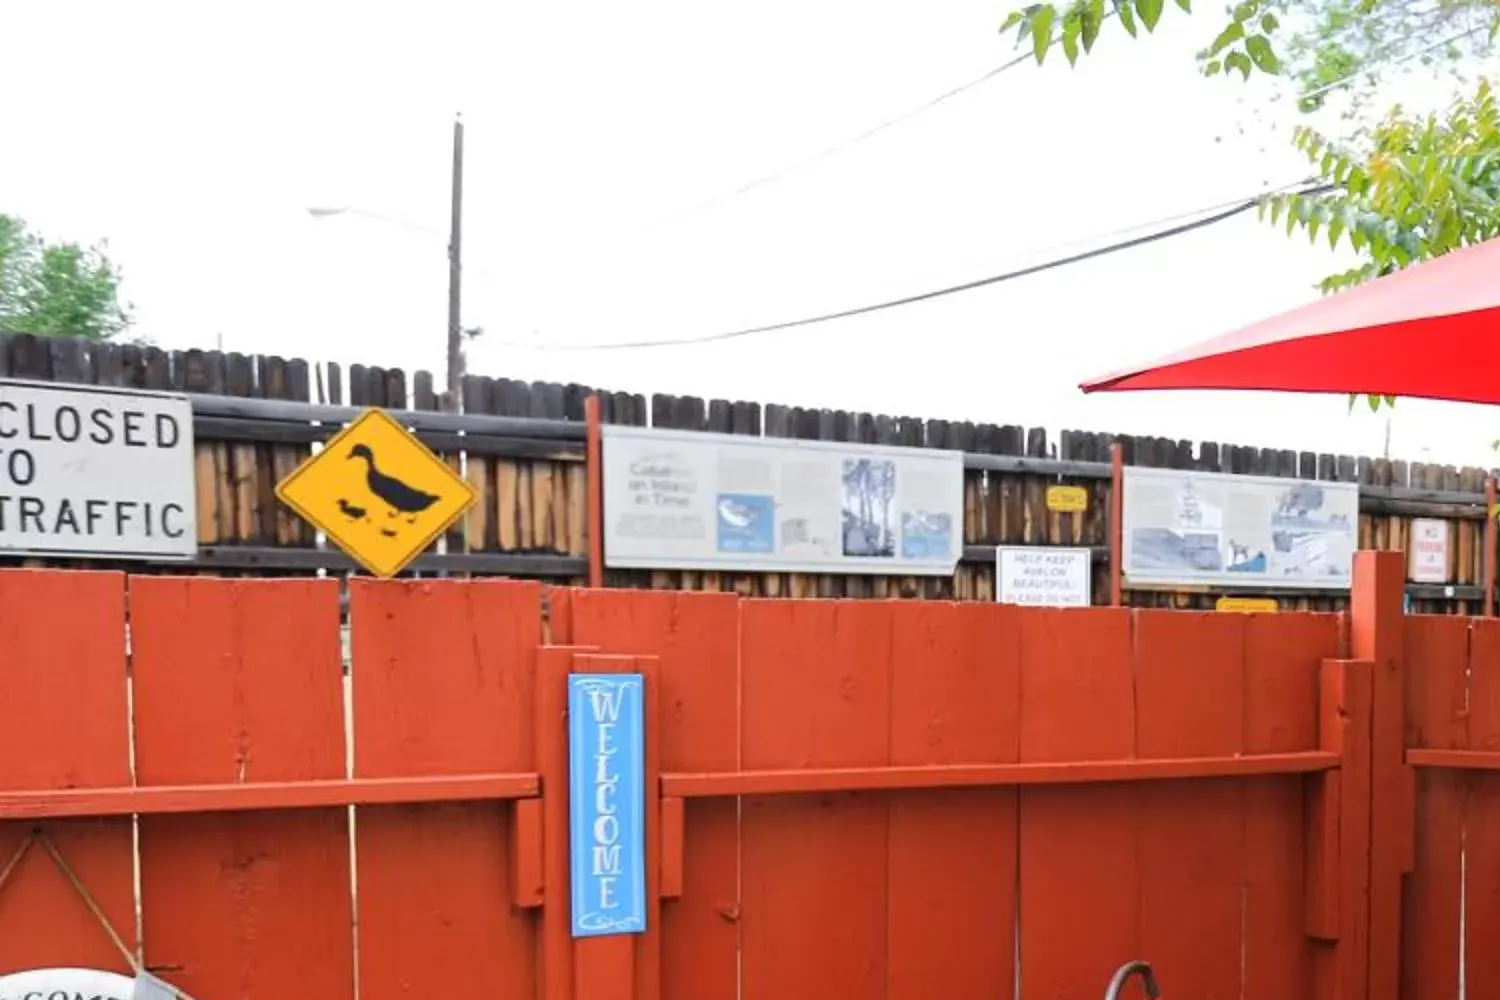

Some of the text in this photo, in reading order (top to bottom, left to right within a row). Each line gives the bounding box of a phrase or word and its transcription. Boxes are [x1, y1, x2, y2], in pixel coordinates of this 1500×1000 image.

[0, 401, 180, 449] CLOSED
[0, 448, 36, 487] O
[576, 678, 640, 911] WELCOME
